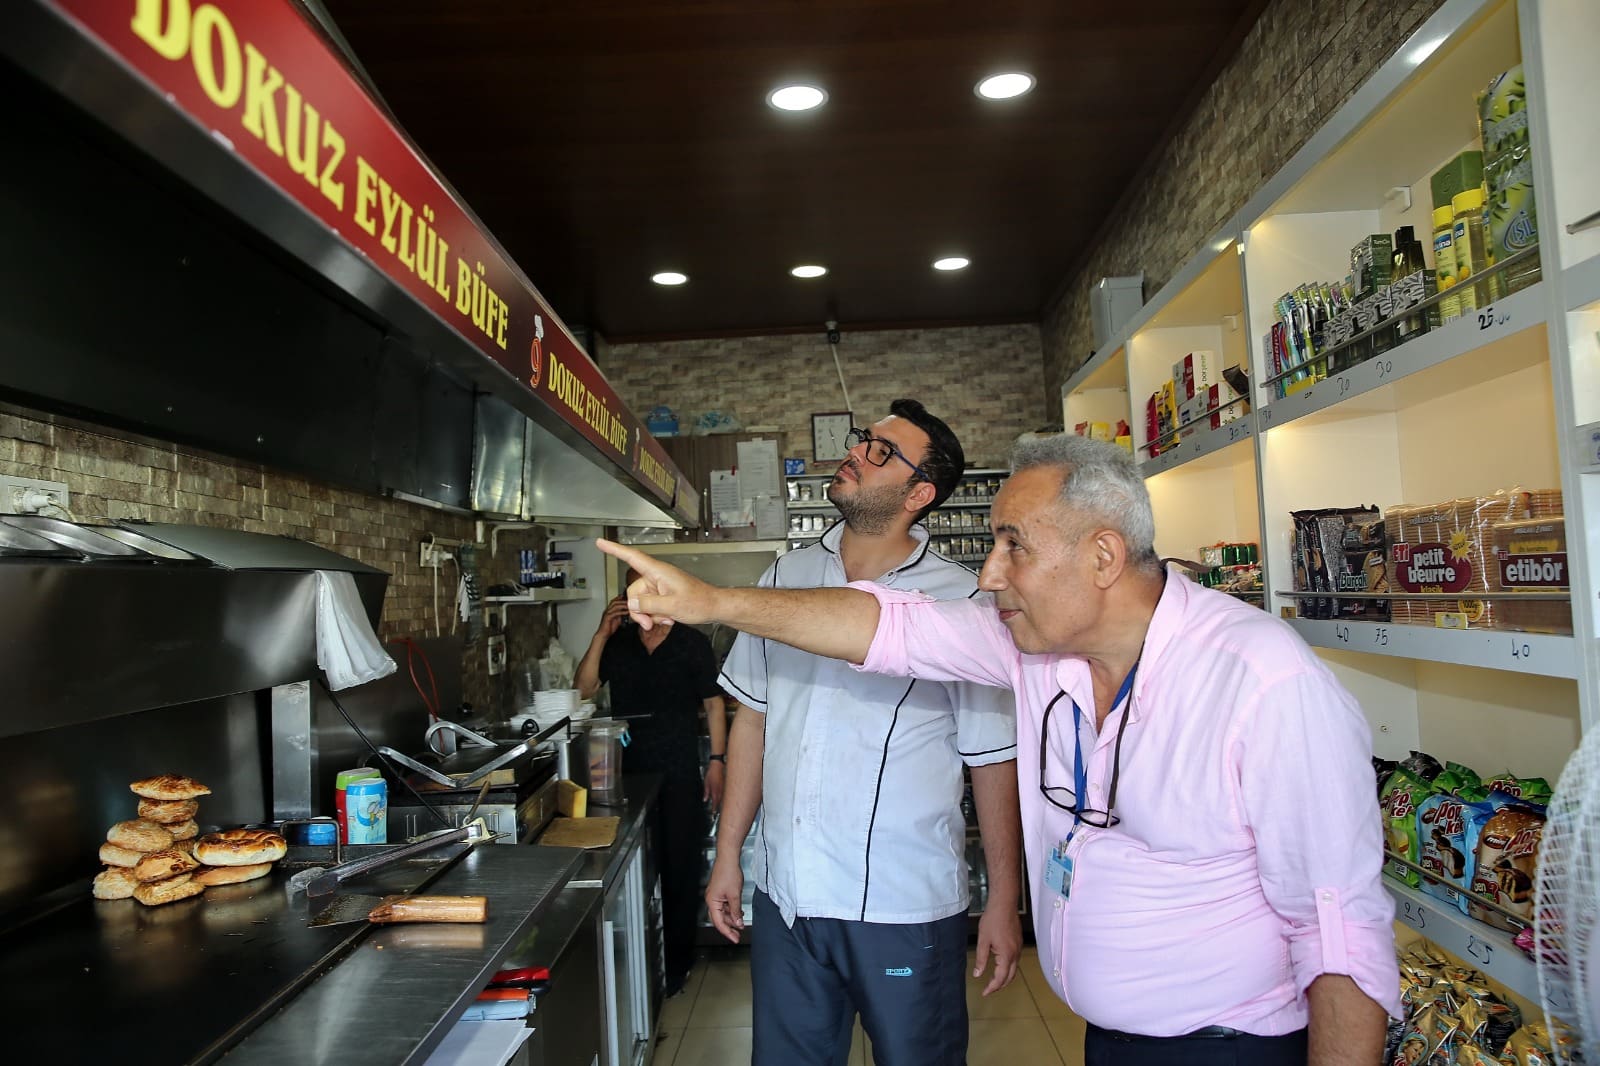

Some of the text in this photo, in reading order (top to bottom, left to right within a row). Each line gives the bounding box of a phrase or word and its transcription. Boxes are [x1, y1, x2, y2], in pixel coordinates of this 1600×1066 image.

[131, 0, 509, 350] DOKUZ EYLÜL BÜFE
[548, 352, 585, 417] DOKUZ
[585, 390, 609, 442] EYLÜL
[1413, 548, 1445, 571] petit
[1506, 557, 1563, 583] etibör
[1408, 566, 1456, 583] beurre
[1336, 623, 1349, 643] 40
[1375, 627, 1389, 646] 75
[1511, 639, 1531, 660] 40
